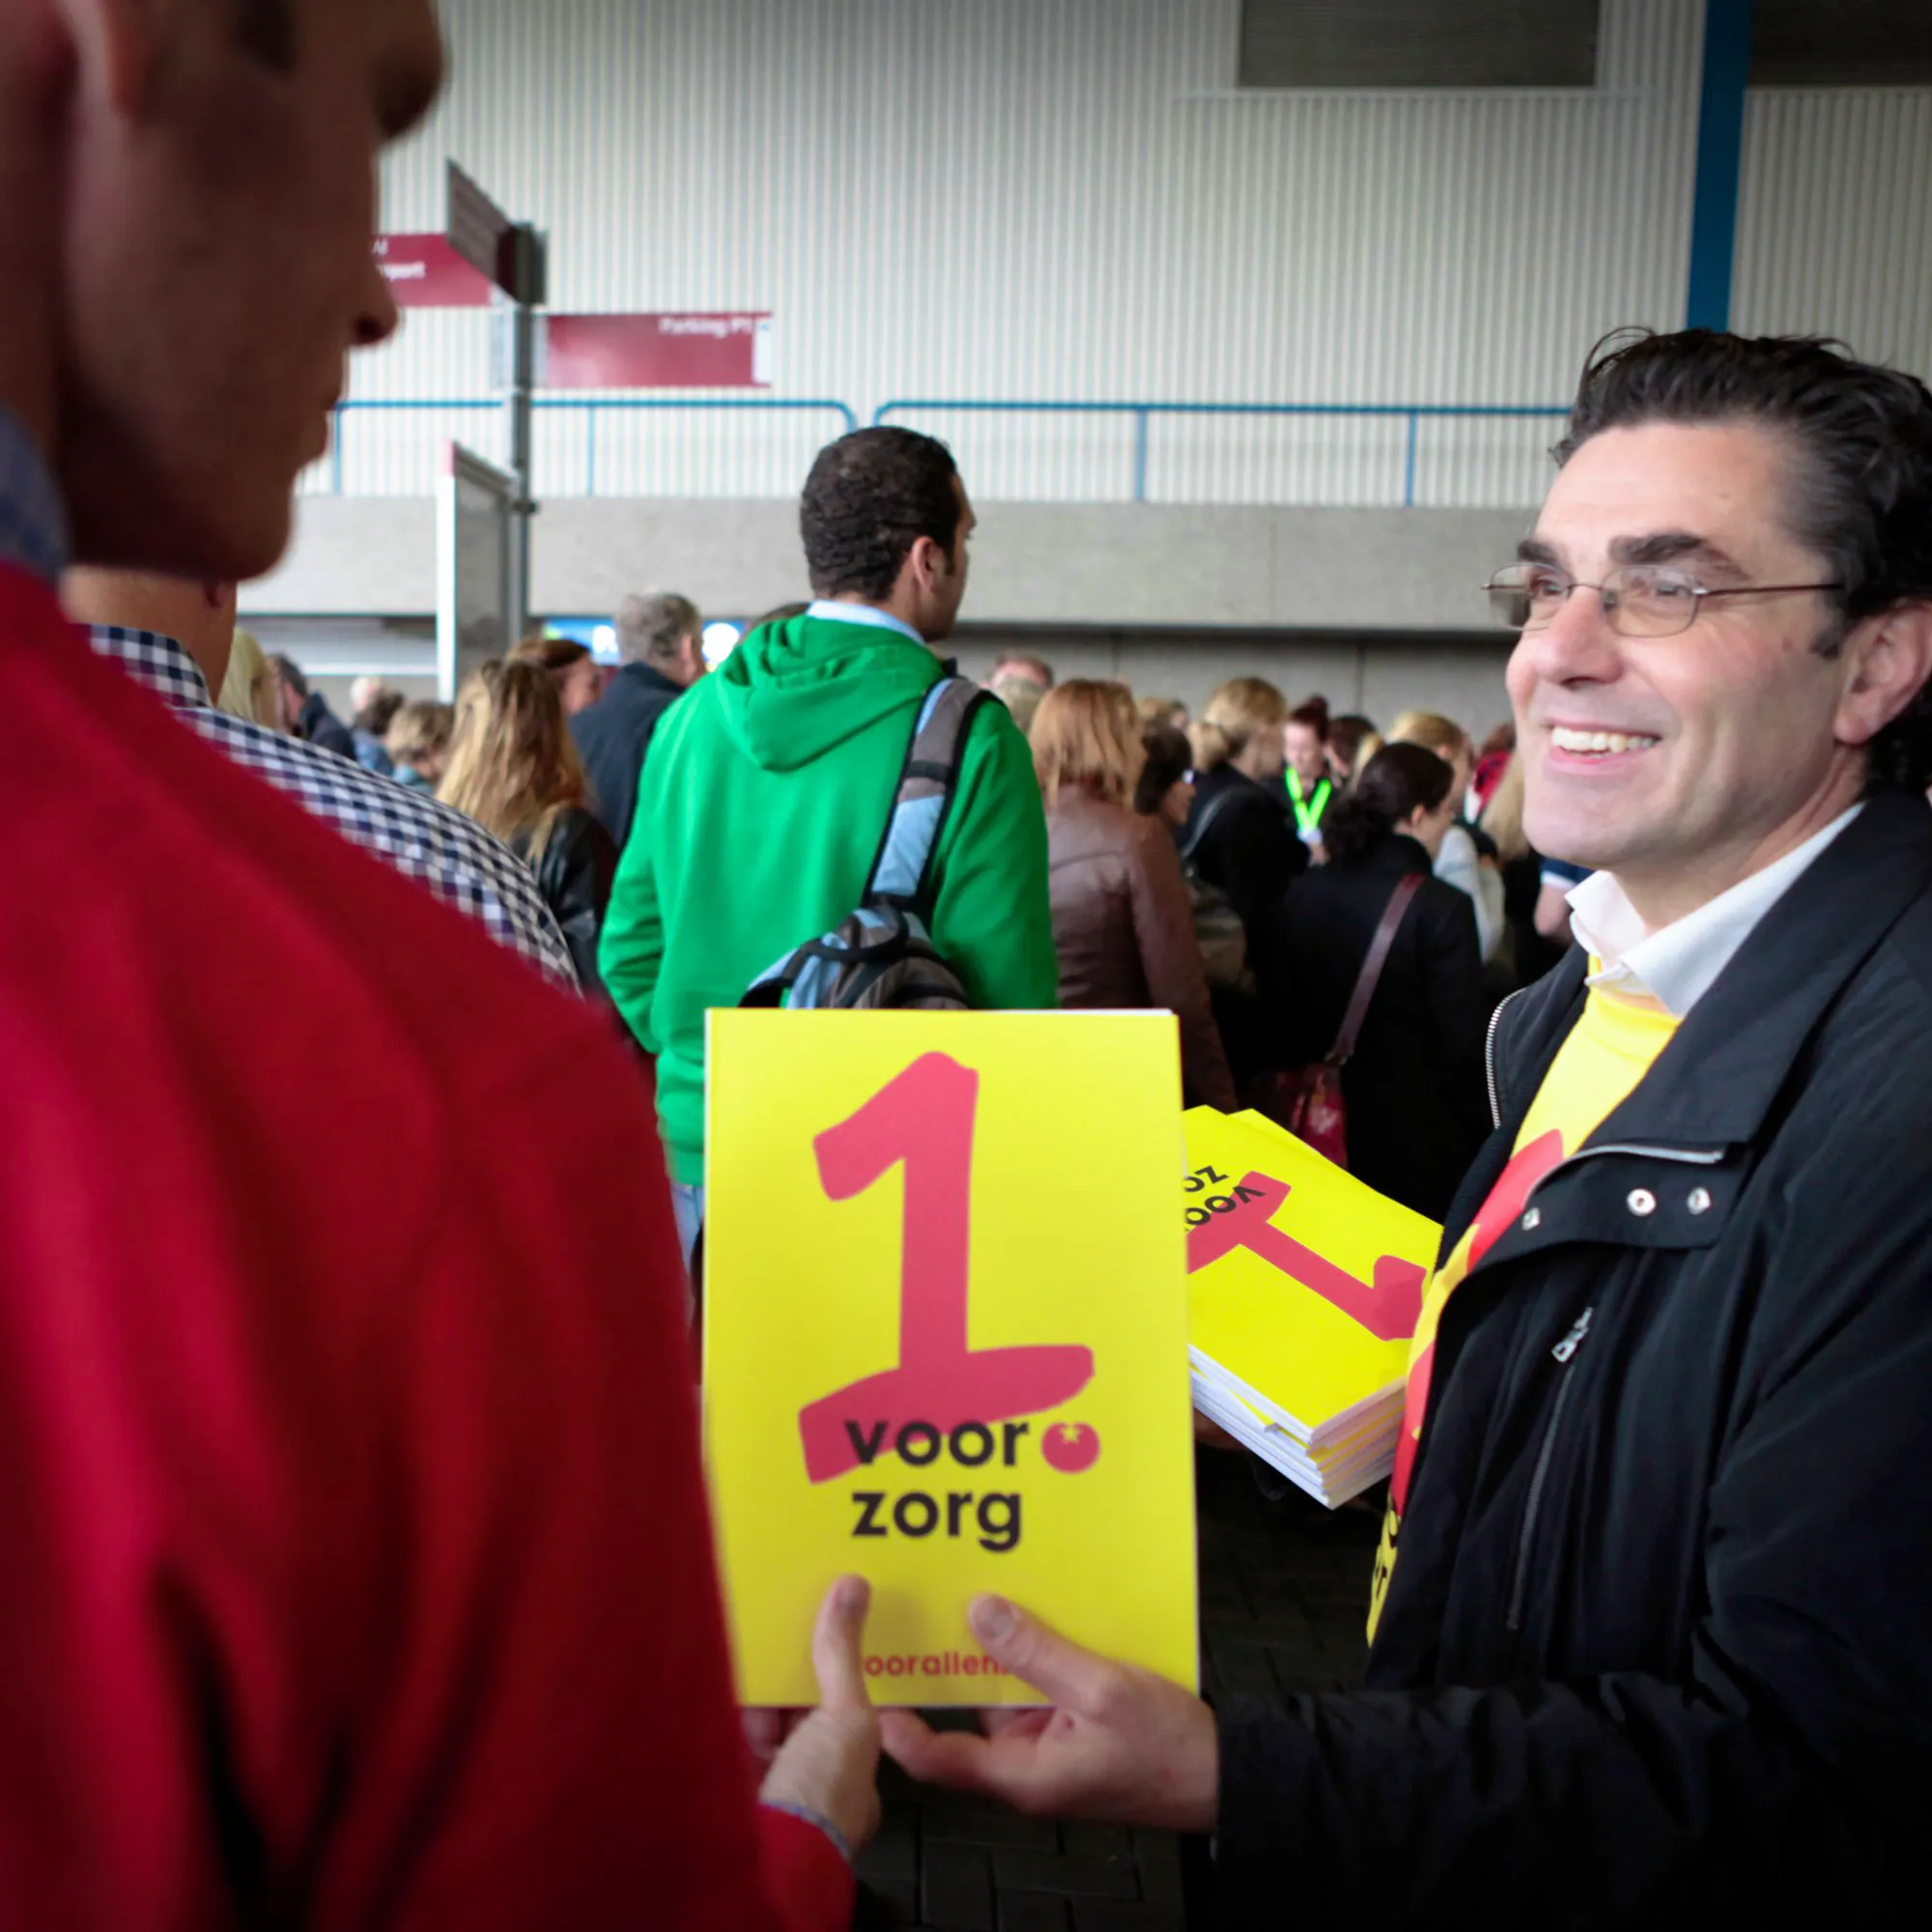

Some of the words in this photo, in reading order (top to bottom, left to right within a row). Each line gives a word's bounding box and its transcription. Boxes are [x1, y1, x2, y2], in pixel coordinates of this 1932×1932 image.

[1183, 1165, 1230, 1193] zo
[1183, 1185, 1267, 1233] voo
[799, 1051, 1094, 1485] 1
[845, 1421, 1029, 1466] voor
[852, 1492, 1021, 1552] zorg
[864, 1651, 1009, 1677] oorallen
